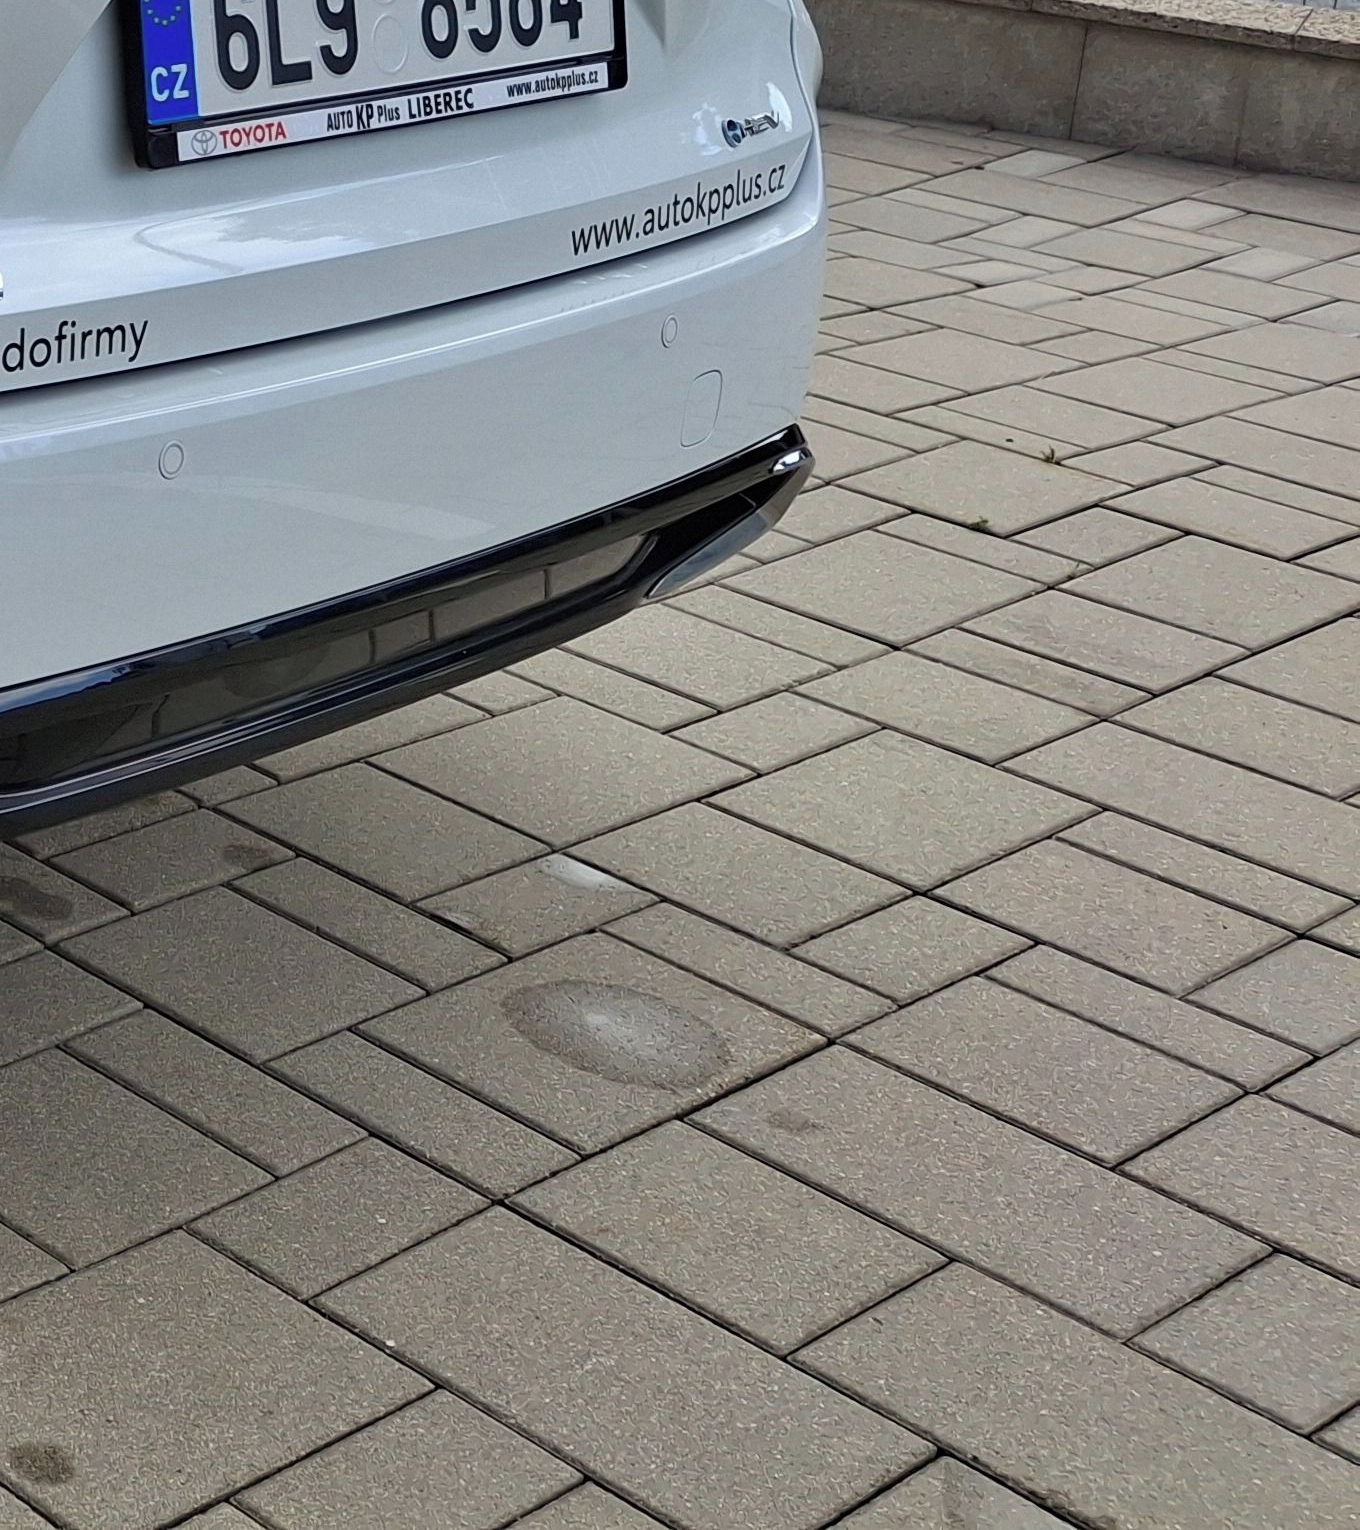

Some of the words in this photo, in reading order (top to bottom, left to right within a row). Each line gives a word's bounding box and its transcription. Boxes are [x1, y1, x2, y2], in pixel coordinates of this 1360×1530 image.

[151, 64, 190, 101] CZ
[219, 121, 287, 149] TOYOTA
[327, 110, 353, 133] AUTO
[356, 104, 375, 131] KP
[377, 105, 401, 124] Plus
[407, 88, 475, 120] LIBEREC
[507, 70, 599, 98] www.autokpplus.cz
[571, 164, 786, 256] www.autokpplus.cz
